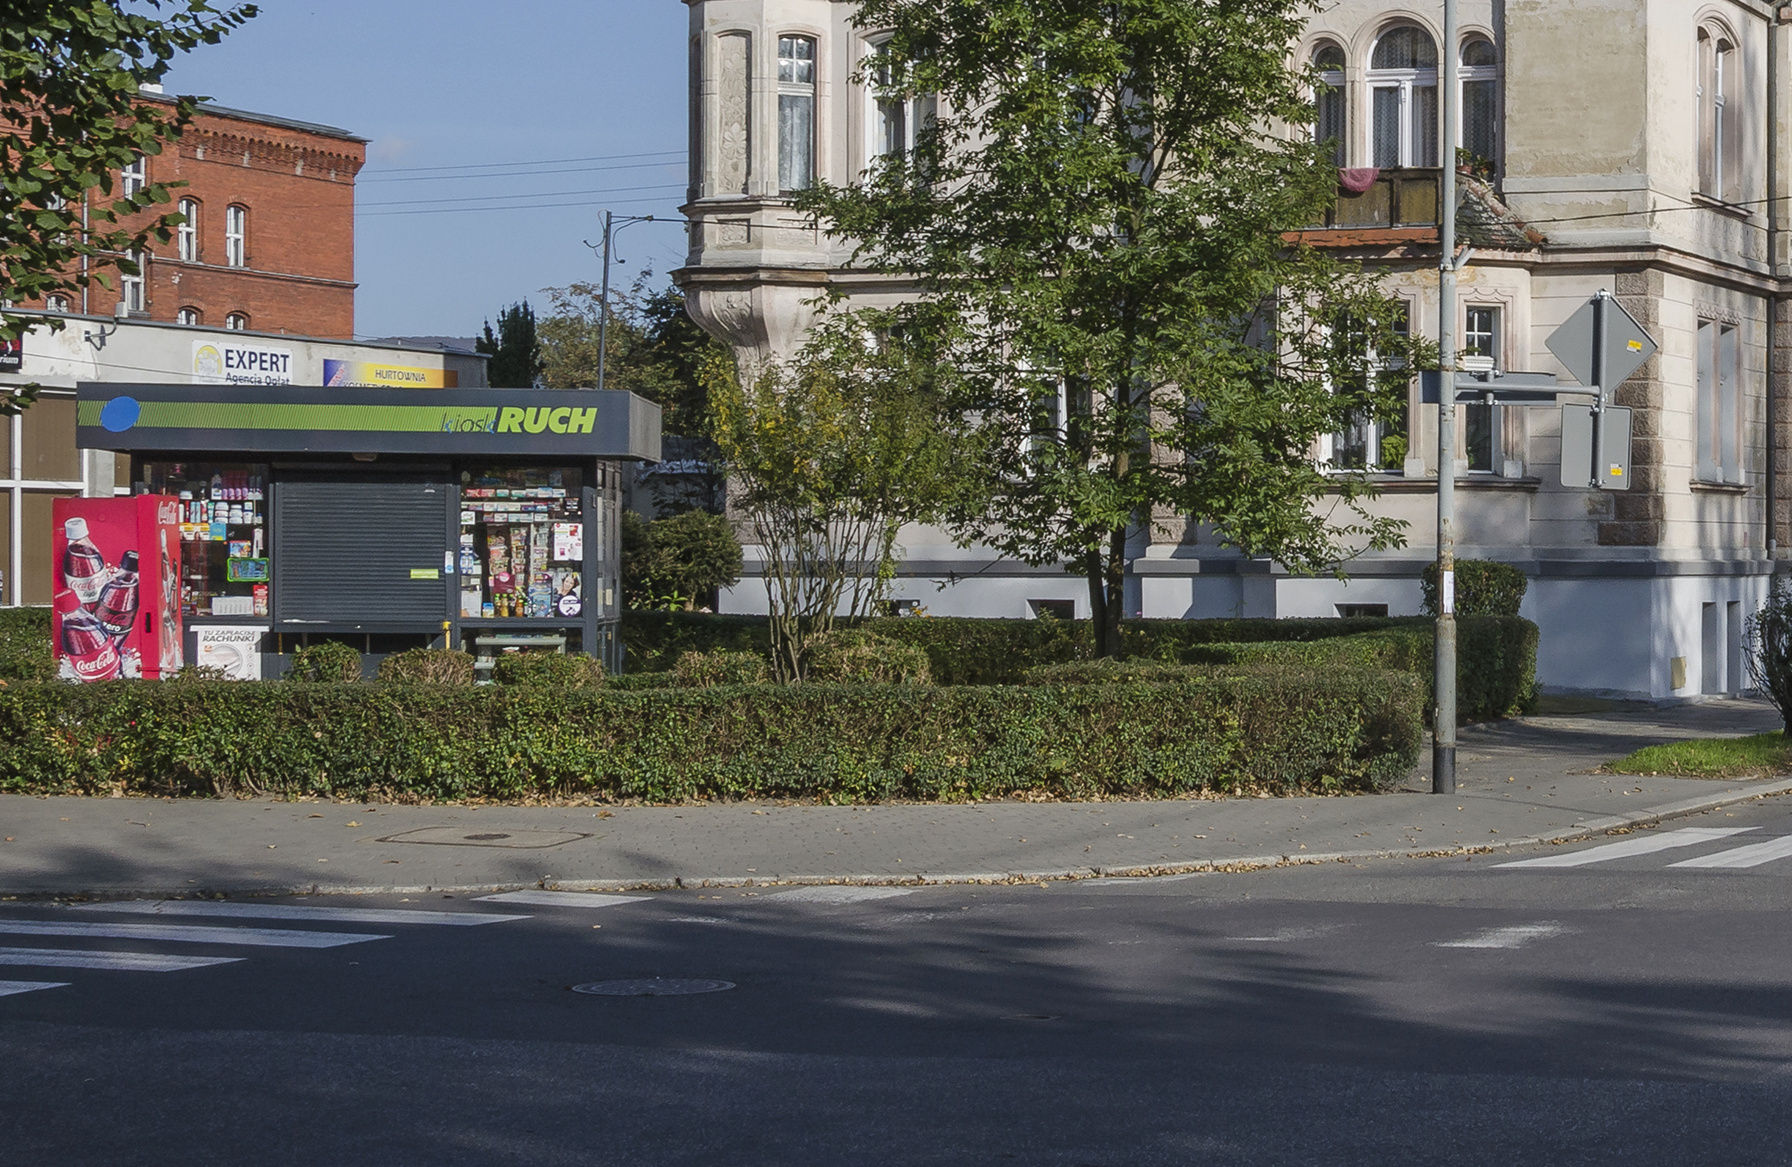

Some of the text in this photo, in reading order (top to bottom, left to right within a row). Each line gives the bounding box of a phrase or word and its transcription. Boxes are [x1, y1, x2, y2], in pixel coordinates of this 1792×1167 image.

[225, 349, 290, 373] EXPERT
[225, 372, 262, 386] Agencja
[375, 369, 427, 382] HURTOWNIA
[441, 407, 598, 434] kiosk RUCH
